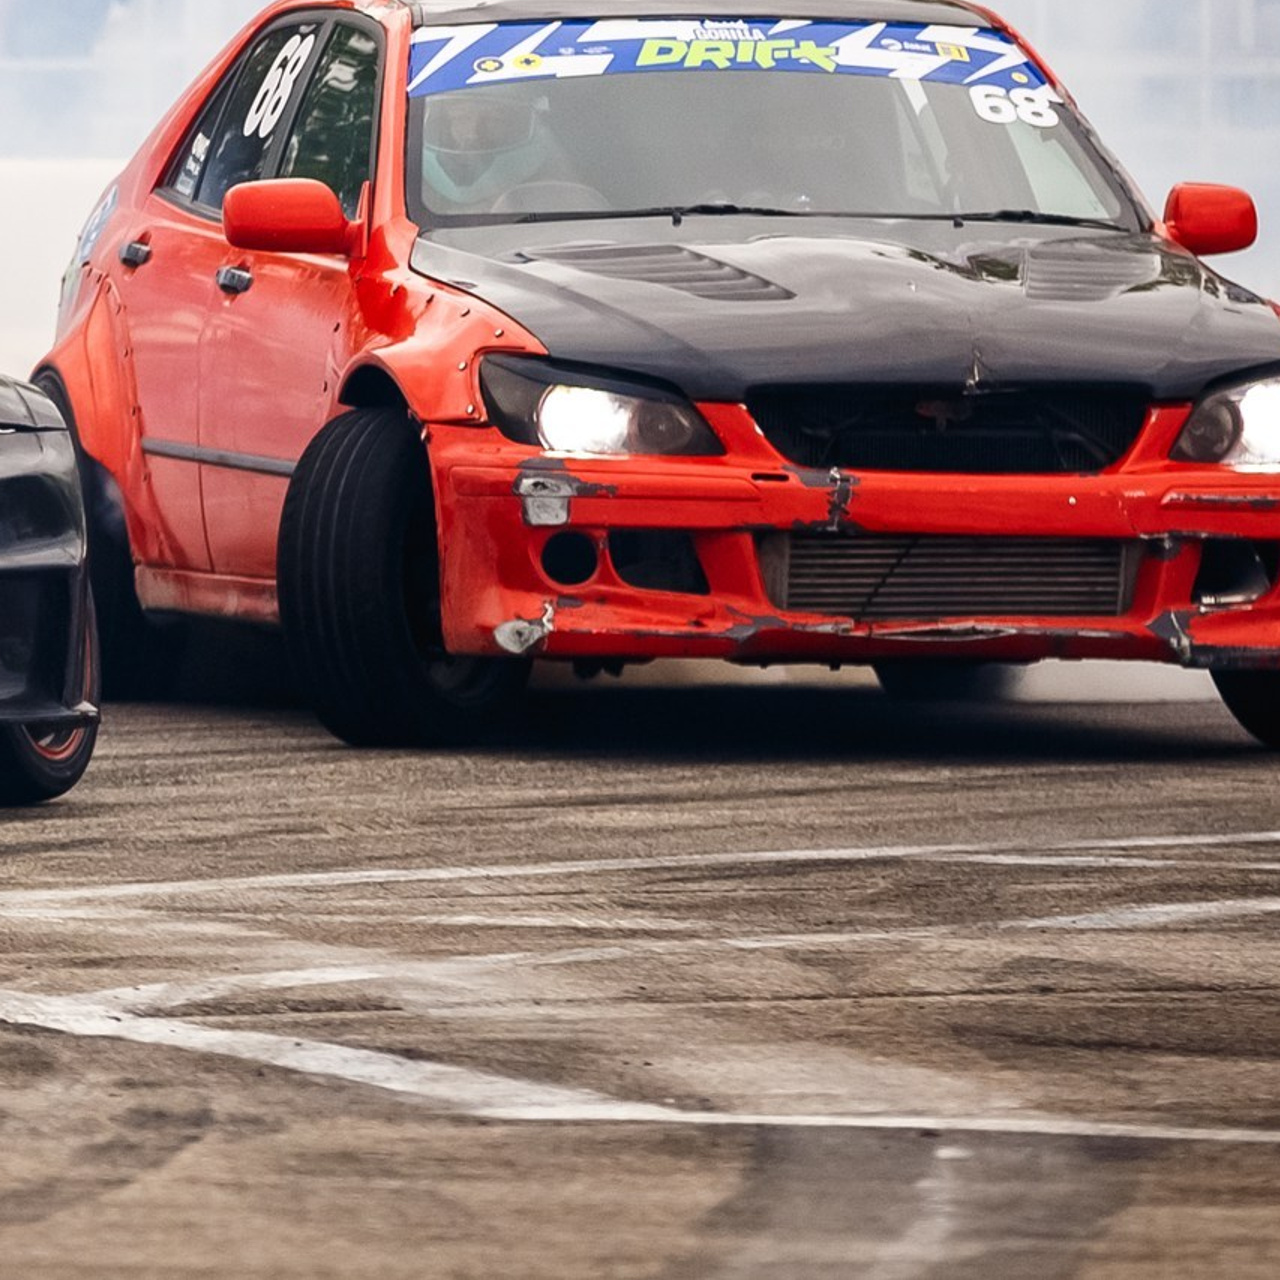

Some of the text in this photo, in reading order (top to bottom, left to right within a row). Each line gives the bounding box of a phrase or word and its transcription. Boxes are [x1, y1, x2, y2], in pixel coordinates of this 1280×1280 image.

[696, 28, 766, 41] GORILLA
[243, 34, 315, 138] 68
[970, 85, 1059, 127] 68
